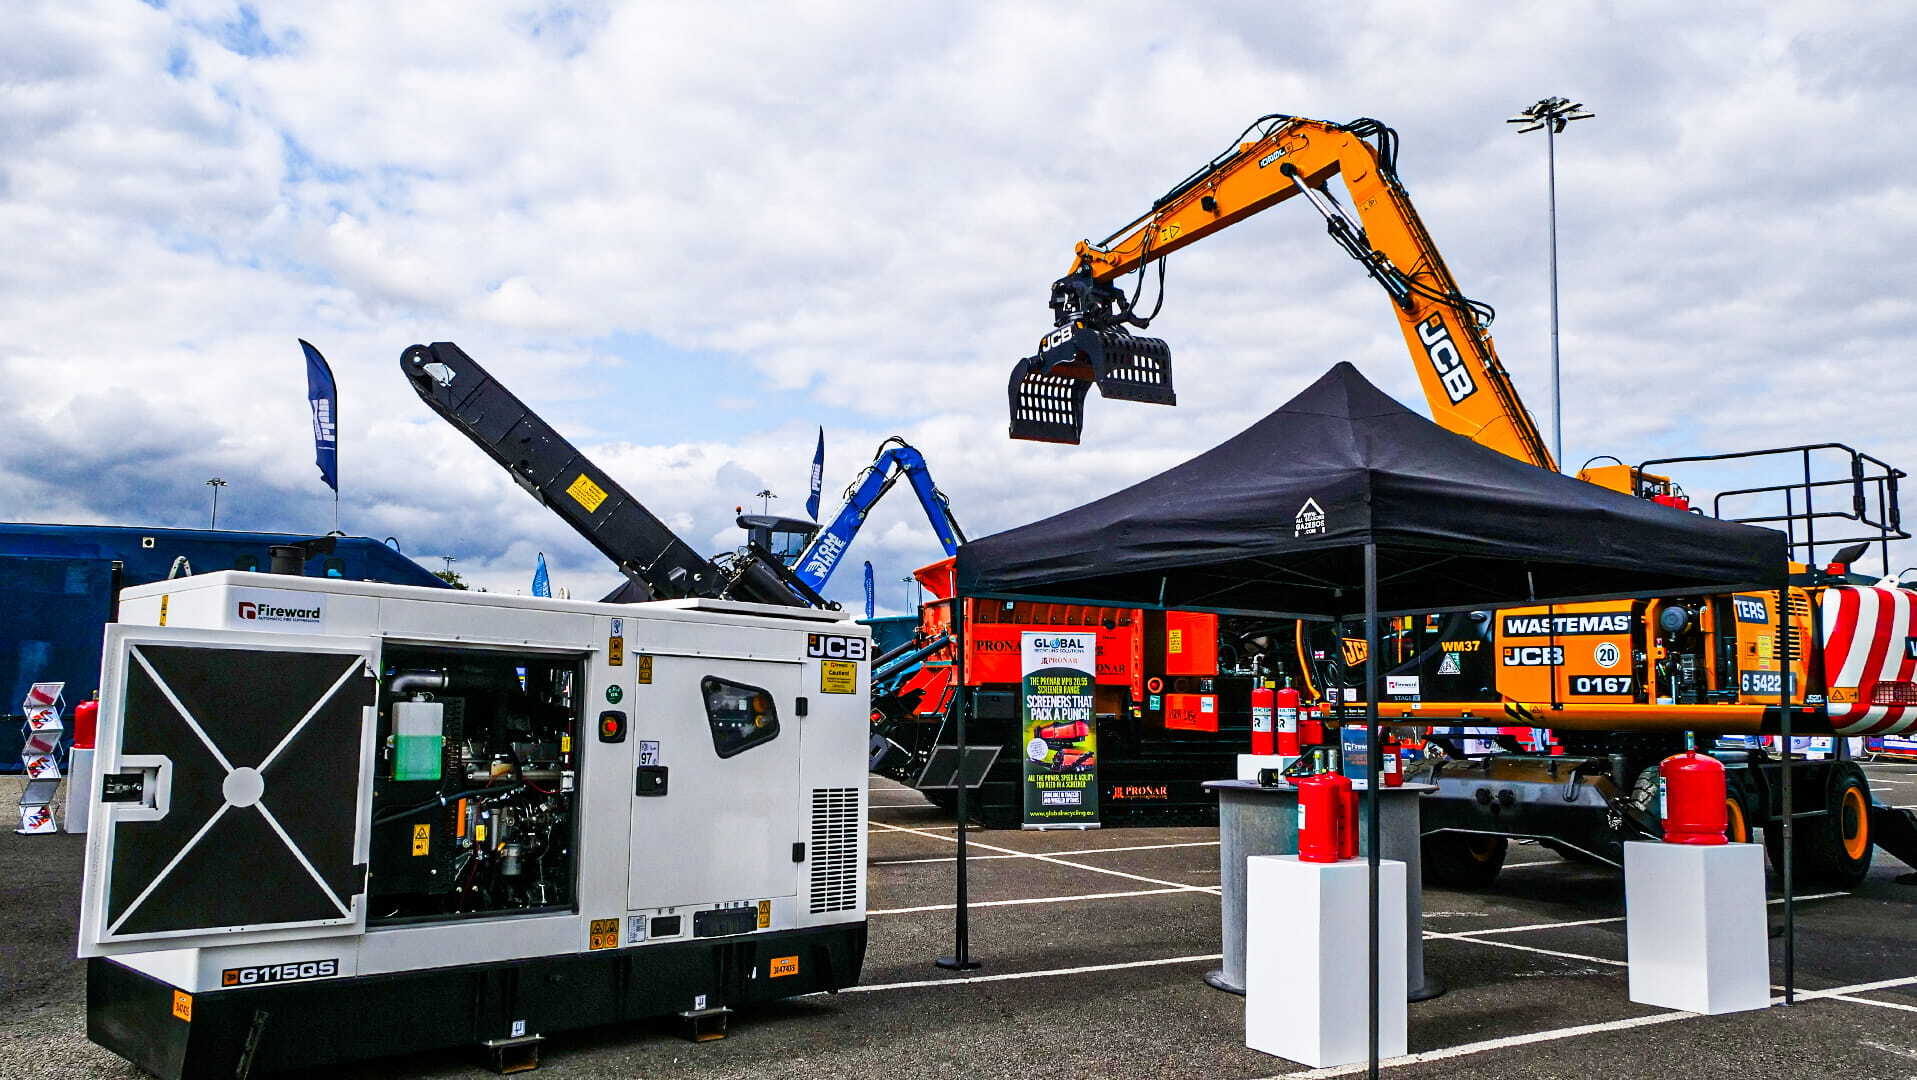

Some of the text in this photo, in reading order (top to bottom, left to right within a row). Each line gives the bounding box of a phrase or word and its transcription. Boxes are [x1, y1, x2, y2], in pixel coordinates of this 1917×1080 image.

[1042, 325, 1073, 352] JCB
[1418, 320, 1473, 402] JCB
[1296, 520, 1325, 530] GAZEBOS
[813, 536, 847, 578] WHITE
[258, 603, 320, 618] Fireward
[1734, 600, 1765, 619] TERS
[1507, 615, 1632, 634] WASTEMAS
[809, 636, 865, 659] JCB
[1034, 638, 1085, 649] GLOBAL
[1442, 640, 1480, 651] WM37
[1504, 647, 1563, 666] JCB
[1600, 648, 1615, 662] 20
[1030, 677, 1039, 686] THE
[1577, 677, 1632, 694] 0167
[1742, 674, 1749, 691] 6
[1027, 696, 1094, 708] SCREENERS THAT
[1031, 708, 1090, 721] PACK A PUNCH
[641, 752, 652, 765] 97
[1126, 786, 1168, 796] PRONAR
[240, 961, 334, 983] G115QS
